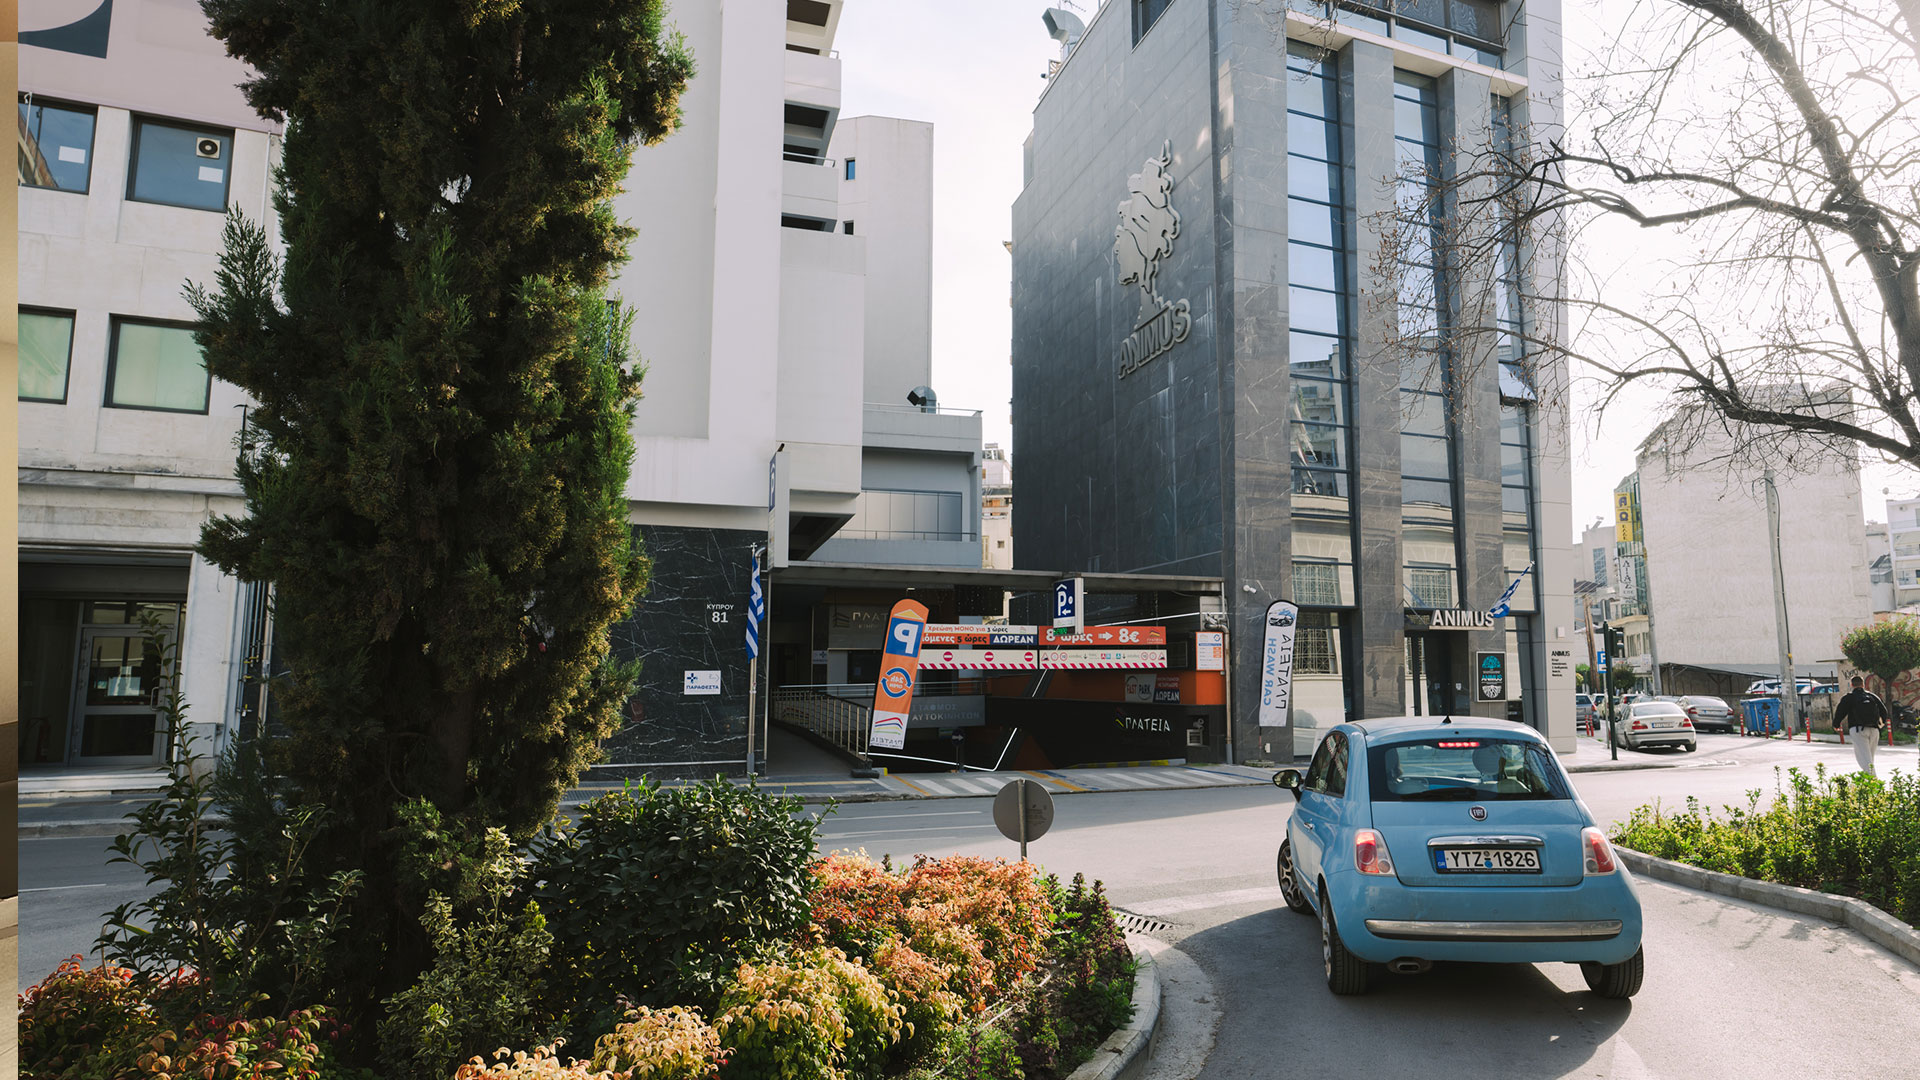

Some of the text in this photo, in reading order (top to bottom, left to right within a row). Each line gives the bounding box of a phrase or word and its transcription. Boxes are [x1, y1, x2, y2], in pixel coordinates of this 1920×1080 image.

[1118, 298, 1191, 379] ANIMUS
[711, 611, 729, 623] 81
[1432, 609, 1495, 627] ANIMUS
[992, 625, 1008, 633] ώρες
[1046, 628, 1056, 642] 8
[1119, 628, 1140, 643] 8€
[957, 635, 962, 643] 5
[964, 634, 987, 644] ώρες
[993, 635, 1034, 644] ΔΩΡΕΑΝ
[1125, 717, 1171, 732] ΠΛΑΤΕΙΑ
